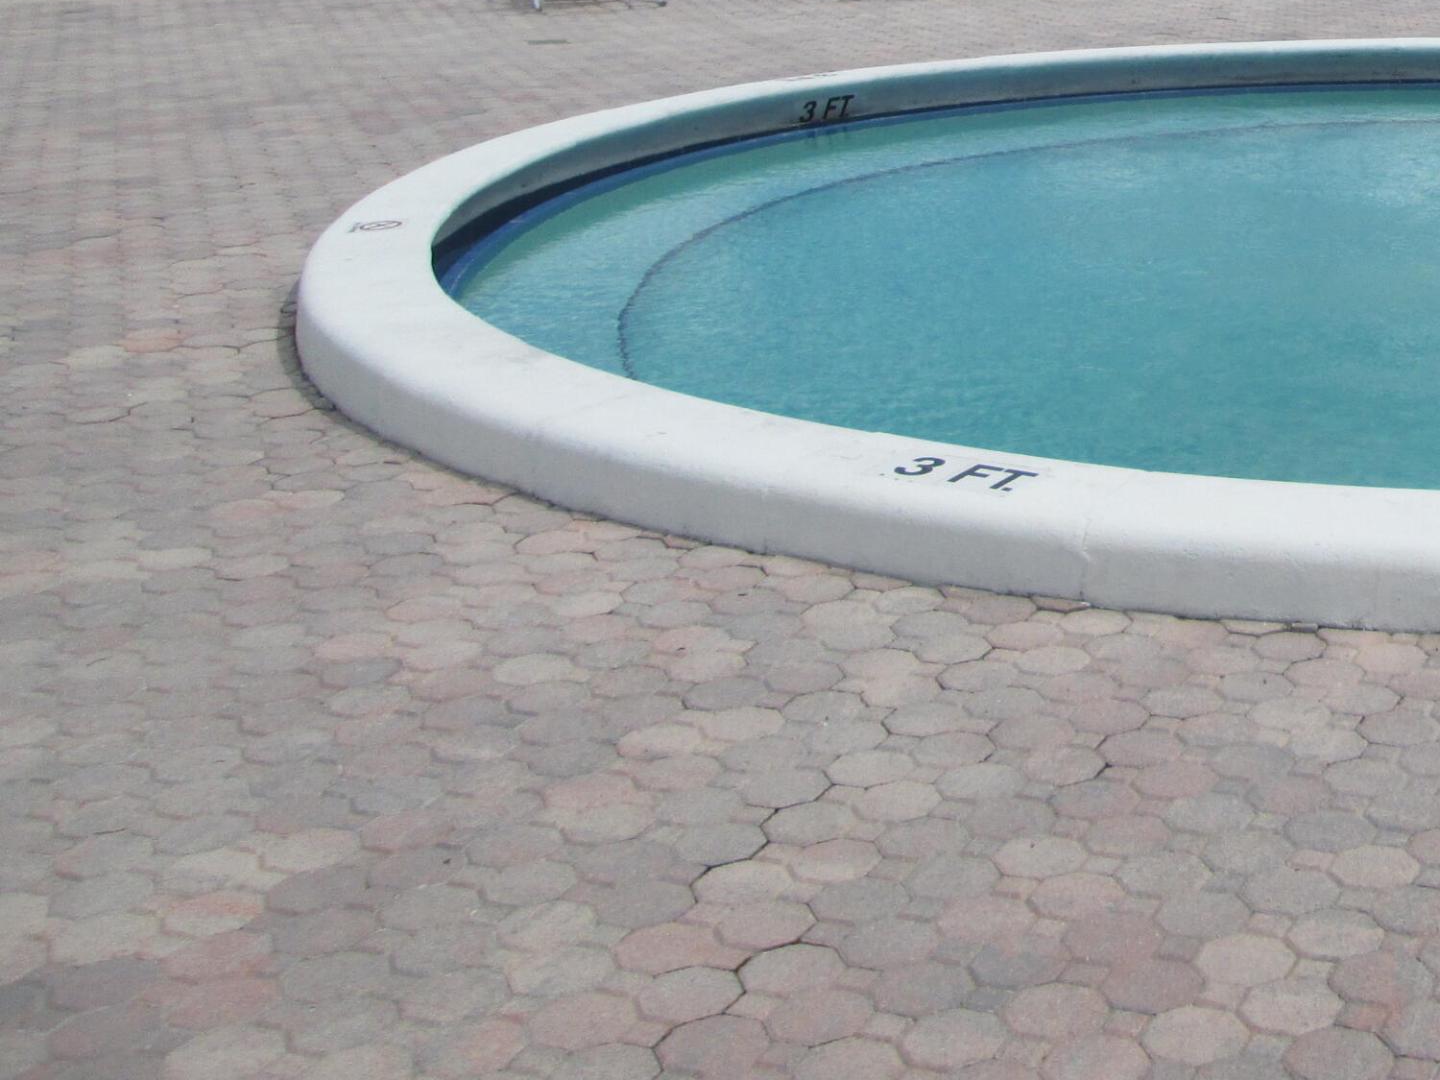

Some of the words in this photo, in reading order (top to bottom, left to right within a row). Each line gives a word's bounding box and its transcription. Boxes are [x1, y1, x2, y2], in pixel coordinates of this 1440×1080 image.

[799, 100, 817, 123] 3
[894, 456, 946, 475] 3
[947, 464, 1039, 493] FT.
